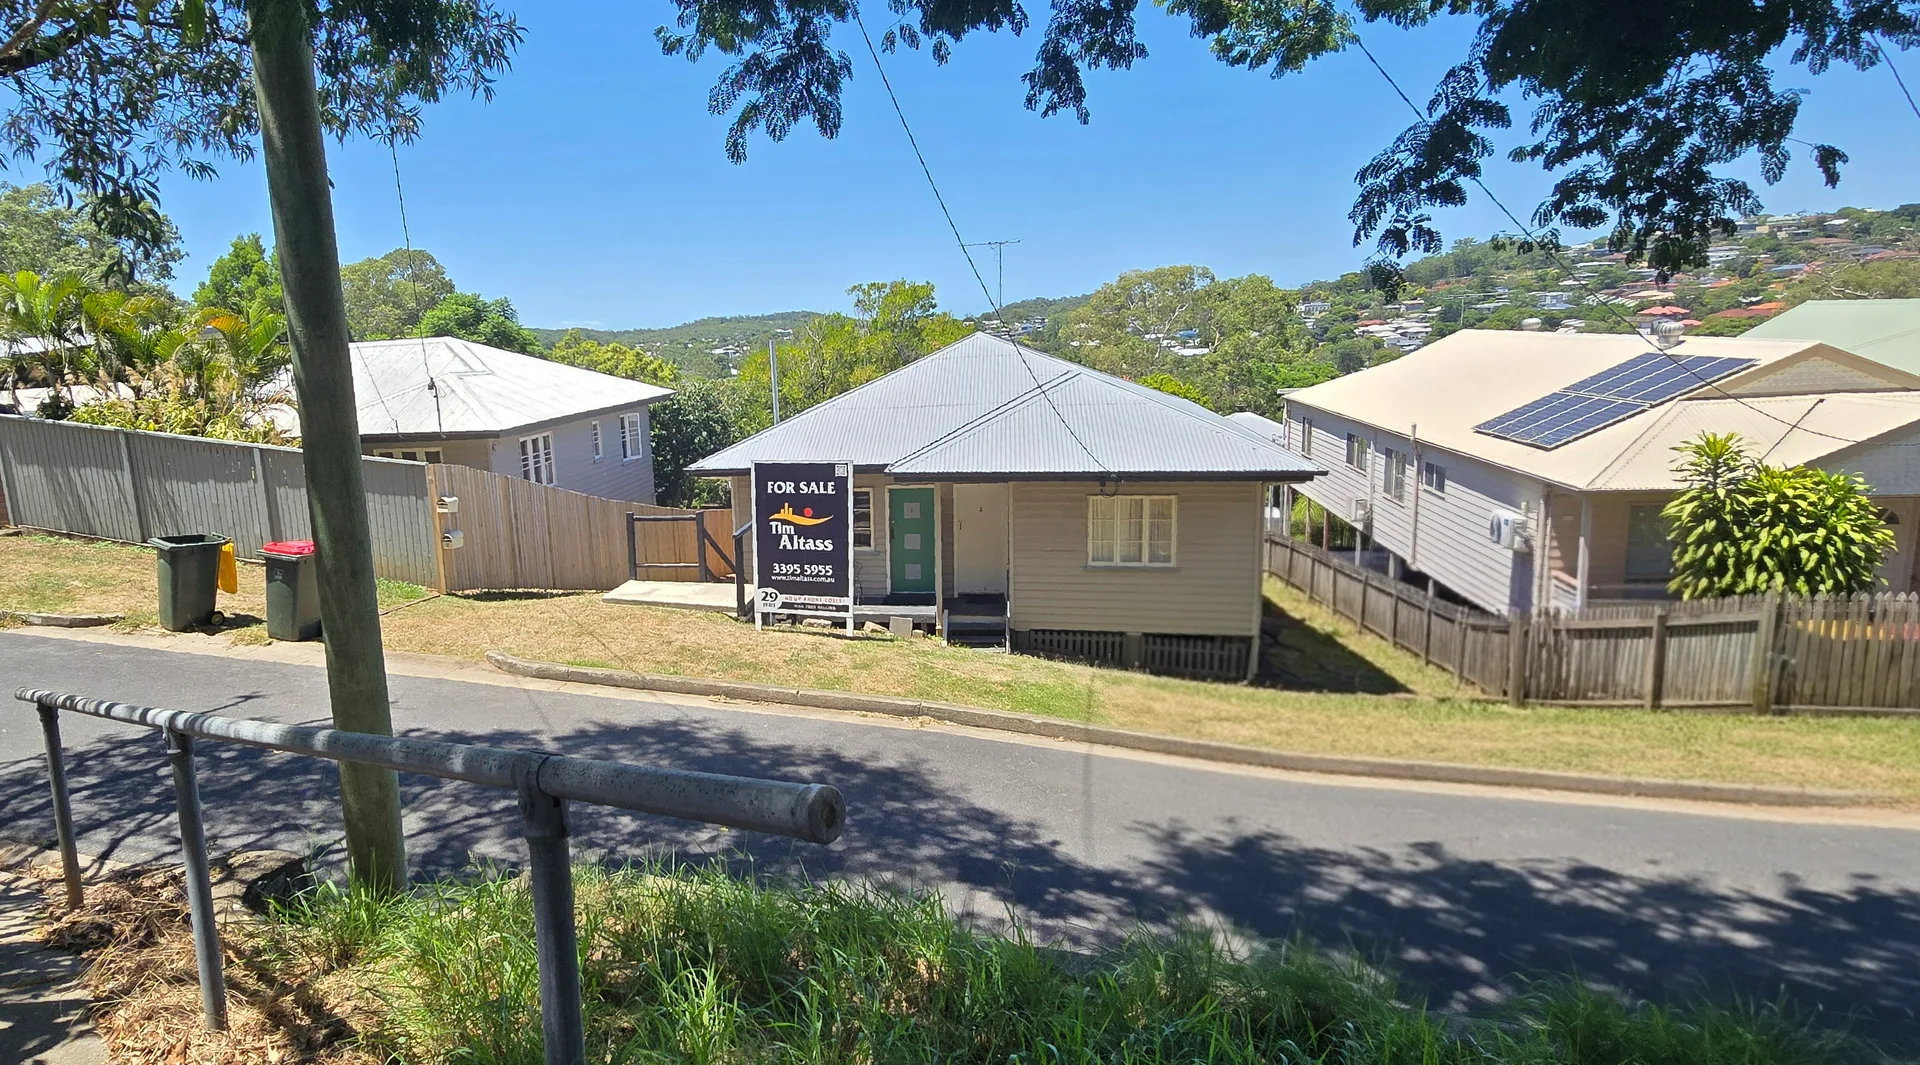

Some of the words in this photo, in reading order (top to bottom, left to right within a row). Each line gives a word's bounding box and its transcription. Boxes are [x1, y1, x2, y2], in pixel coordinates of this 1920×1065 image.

[767, 481, 796, 494] FOR
[799, 481, 836, 495] SALE
[769, 521, 795, 535] Tim
[778, 535, 834, 551] Altass
[772, 563, 801, 575] 3395
[804, 564, 833, 576] 5955
[770, 574, 835, 583] www.timaltass.com.au
[761, 591, 778, 602] 29
